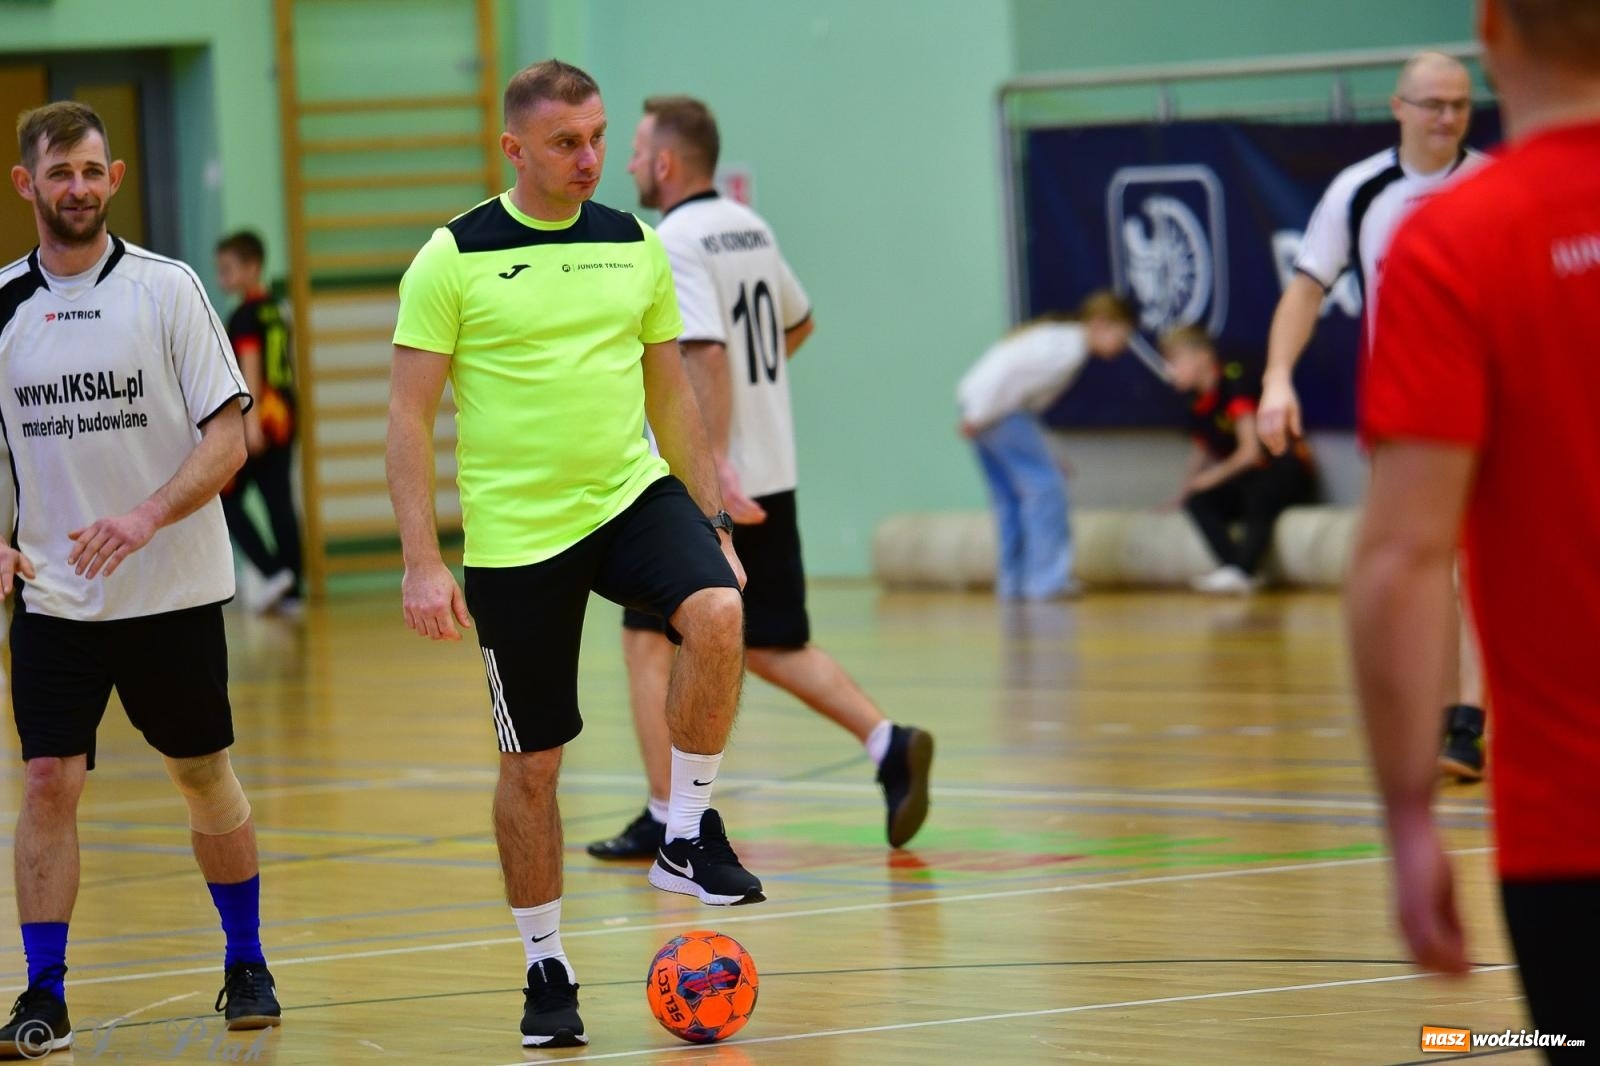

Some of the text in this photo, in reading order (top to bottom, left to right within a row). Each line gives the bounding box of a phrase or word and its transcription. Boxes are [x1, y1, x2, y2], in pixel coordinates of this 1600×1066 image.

[57, 309, 101, 321] PATRICK
[731, 279, 779, 385] 10
[14, 369, 144, 407] www.IKSAL.pl
[22, 409, 148, 440] materiały budowlane
[657, 967, 686, 1023] SELECT
